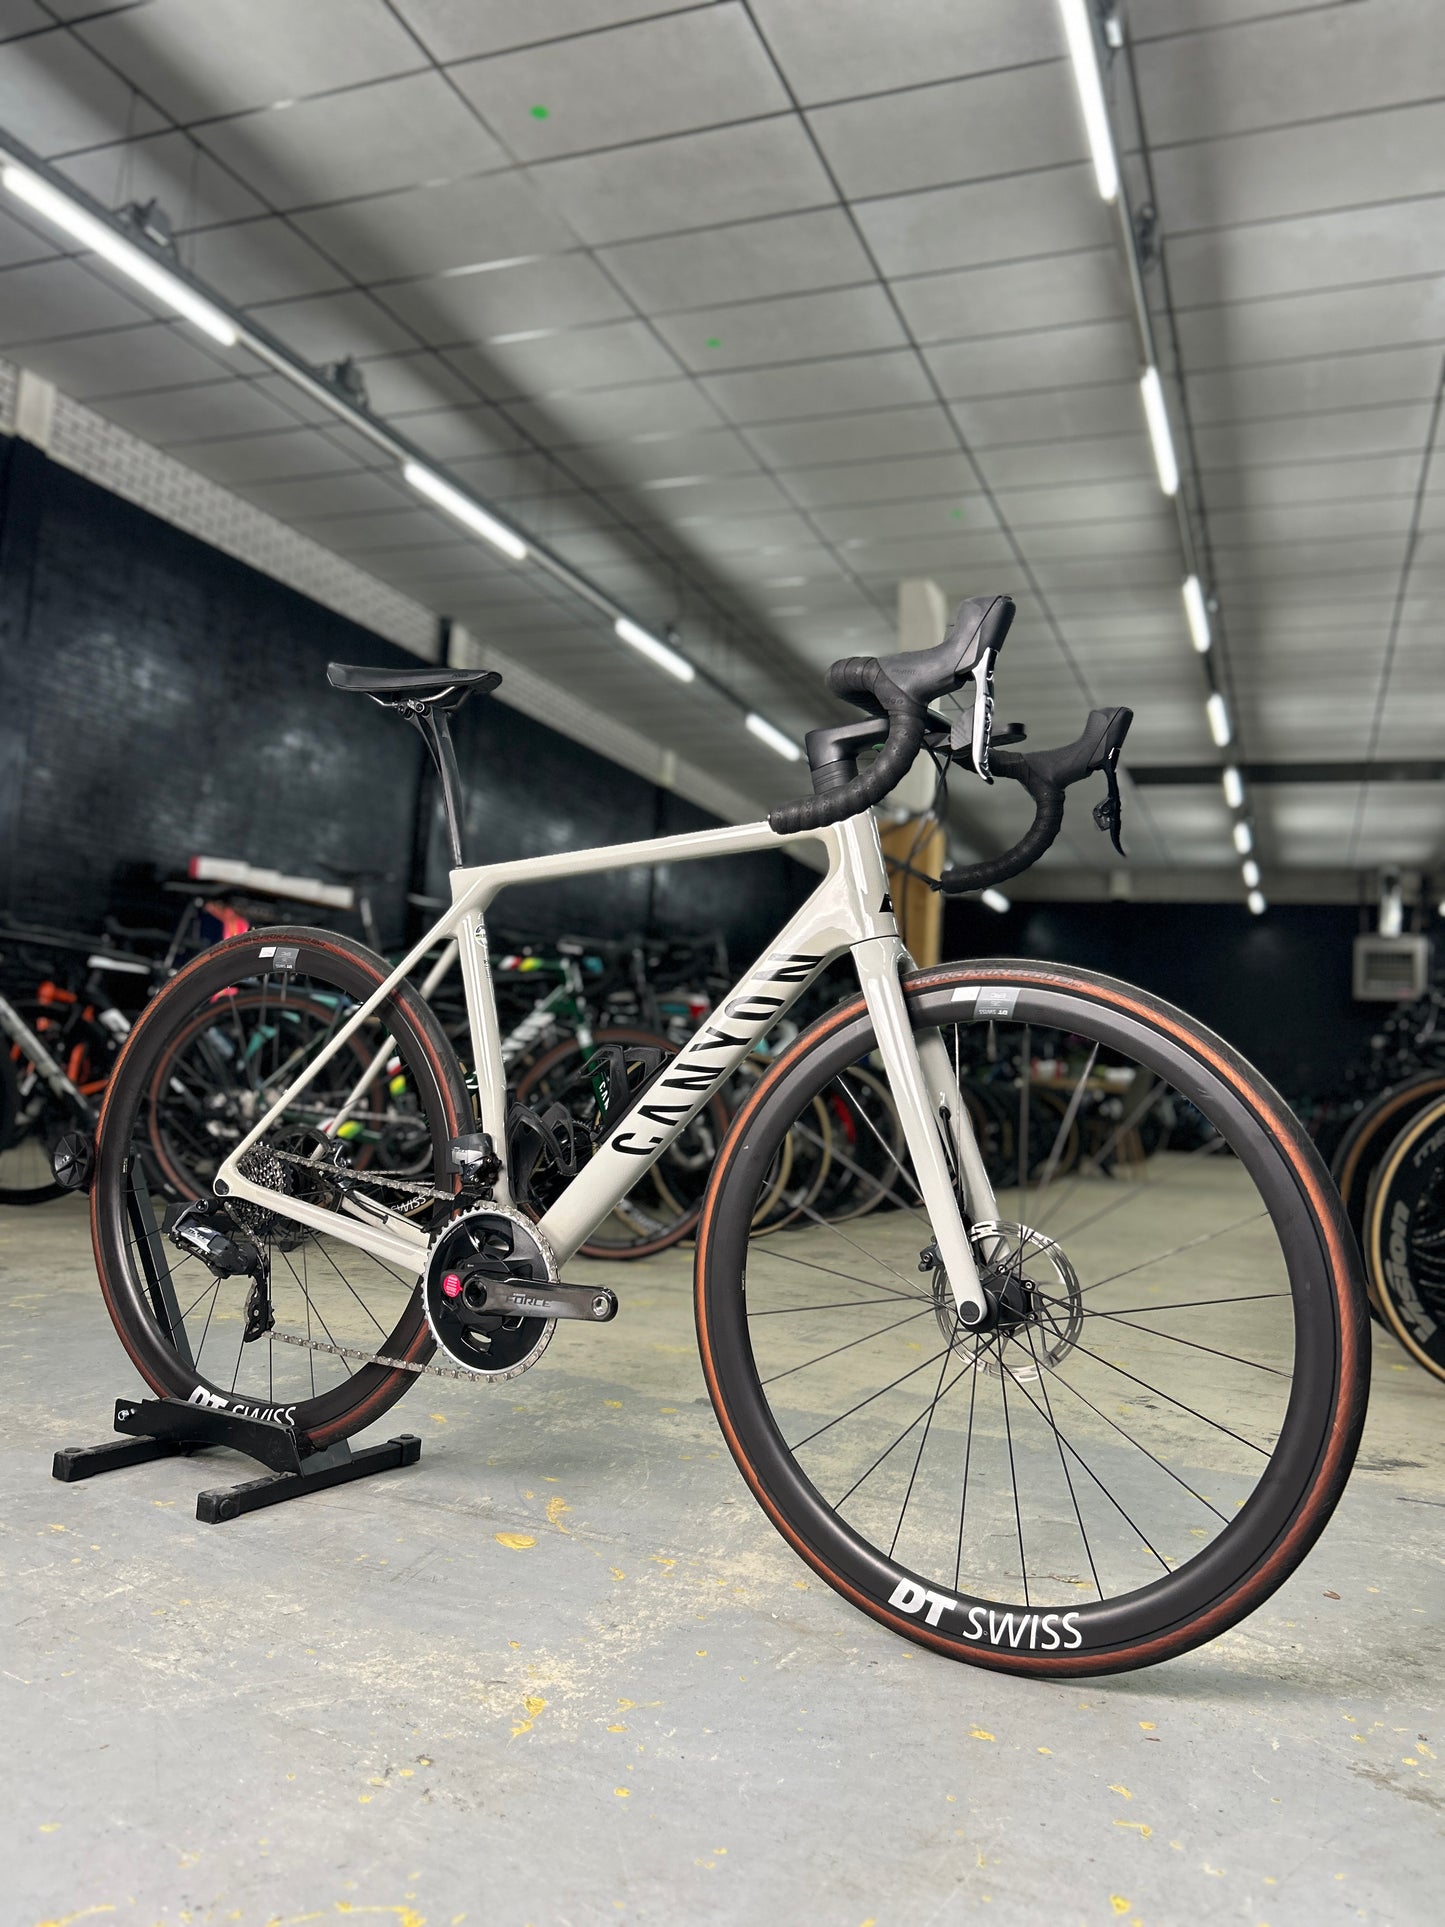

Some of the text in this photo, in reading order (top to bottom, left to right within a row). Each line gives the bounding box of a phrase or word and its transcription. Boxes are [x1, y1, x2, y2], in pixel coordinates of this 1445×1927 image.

[611, 953, 826, 1156] CANYON
[506, 1295, 551, 1307] FORCE
[888, 1577, 1082, 1650] DT SWISS
